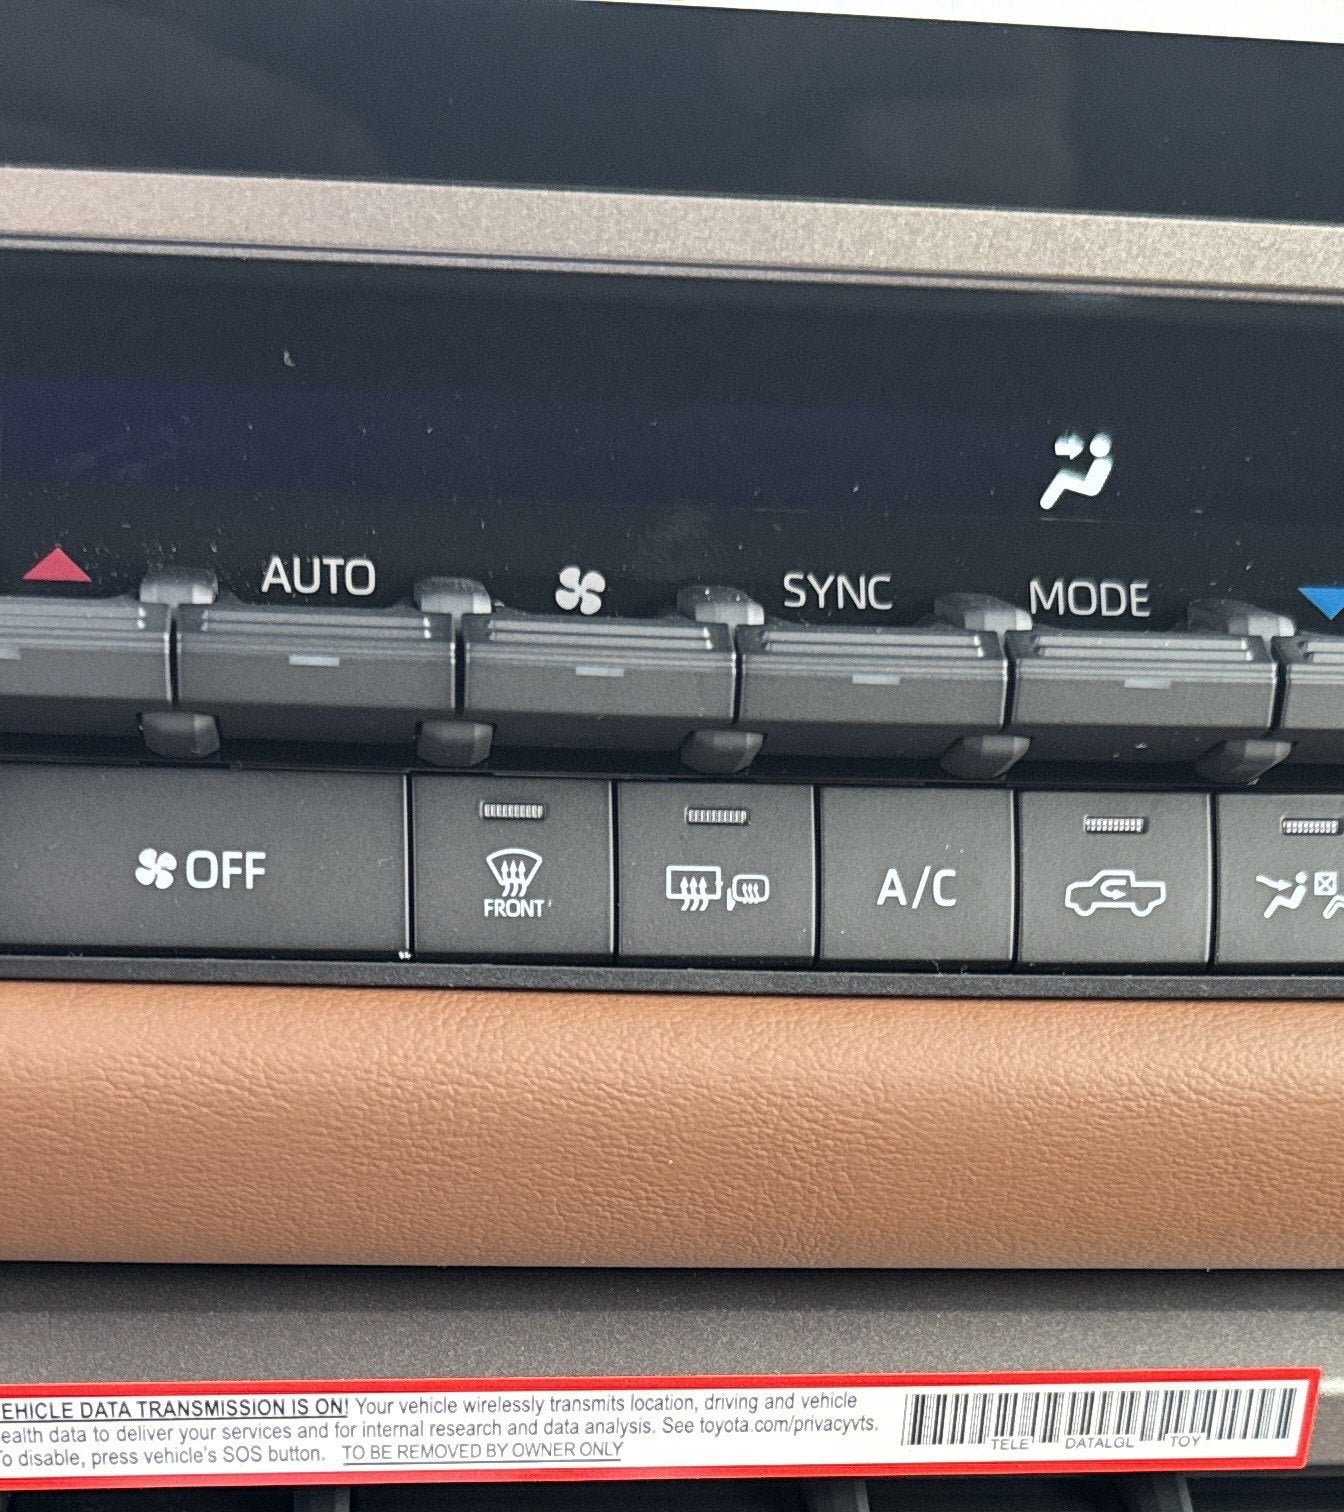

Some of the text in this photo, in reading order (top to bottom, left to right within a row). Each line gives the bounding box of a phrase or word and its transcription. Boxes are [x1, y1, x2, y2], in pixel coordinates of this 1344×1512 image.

[261, 555, 376, 596] AUTO
[782, 572, 893, 611] SYNC
[1029, 578, 1151, 617] MODE
[186, 850, 267, 889] OFF
[877, 865, 957, 909] A/C
[484, 898, 545, 918] FRONT
[80, 1400, 132, 1418] DATA
[137, 1398, 285, 1418] TRANSMISSION
[292, 1398, 309, 1415] IS
[315, 1397, 348, 1415] ON!
[355, 1397, 394, 1415] Your
[399, 1396, 457, 1415] vehicle
[463, 1394, 545, 1416] wirelessly
[550, 1393, 625, 1412] transmits
[630, 1393, 698, 1413] location,
[705, 1393, 758, 1414] driving
[765, 1392, 794, 1409] and
[801, 1391, 857, 1409] vehicle
[49, 1426, 87, 1443] data
[93, 1426, 110, 1442] to
[117, 1425, 173, 1442] deliver
[179, 1427, 216, 1445] your
[221, 1423, 291, 1440] services
[297, 1422, 328, 1439] and
[335, 1421, 357, 1438] for
[362, 1420, 424, 1437] internal
[429, 1419, 501, 1437] research
[507, 1418, 538, 1436] and
[544, 1418, 579, 1435] data
[585, 1417, 656, 1438] analysis.
[662, 1416, 694, 1434] See
[700, 1415, 879, 1437] toyota.com/privacyvts.
[990, 1438, 1030, 1450] TELE
[1170, 1435, 1202, 1448] TOY
[18, 1449, 85, 1468] disable,
[92, 1451, 138, 1469] press
[144, 1446, 217, 1464] vehicle's
[222, 1445, 263, 1462] SOS
[268, 1445, 325, 1462] button.
[342, 1445, 365, 1460] TO
[370, 1444, 392, 1459] BE
[397, 1443, 481, 1458] REMOVED
[486, 1442, 508, 1457] BY
[512, 1441, 575, 1457] OWNER
[579, 1441, 624, 1456] ONLY
